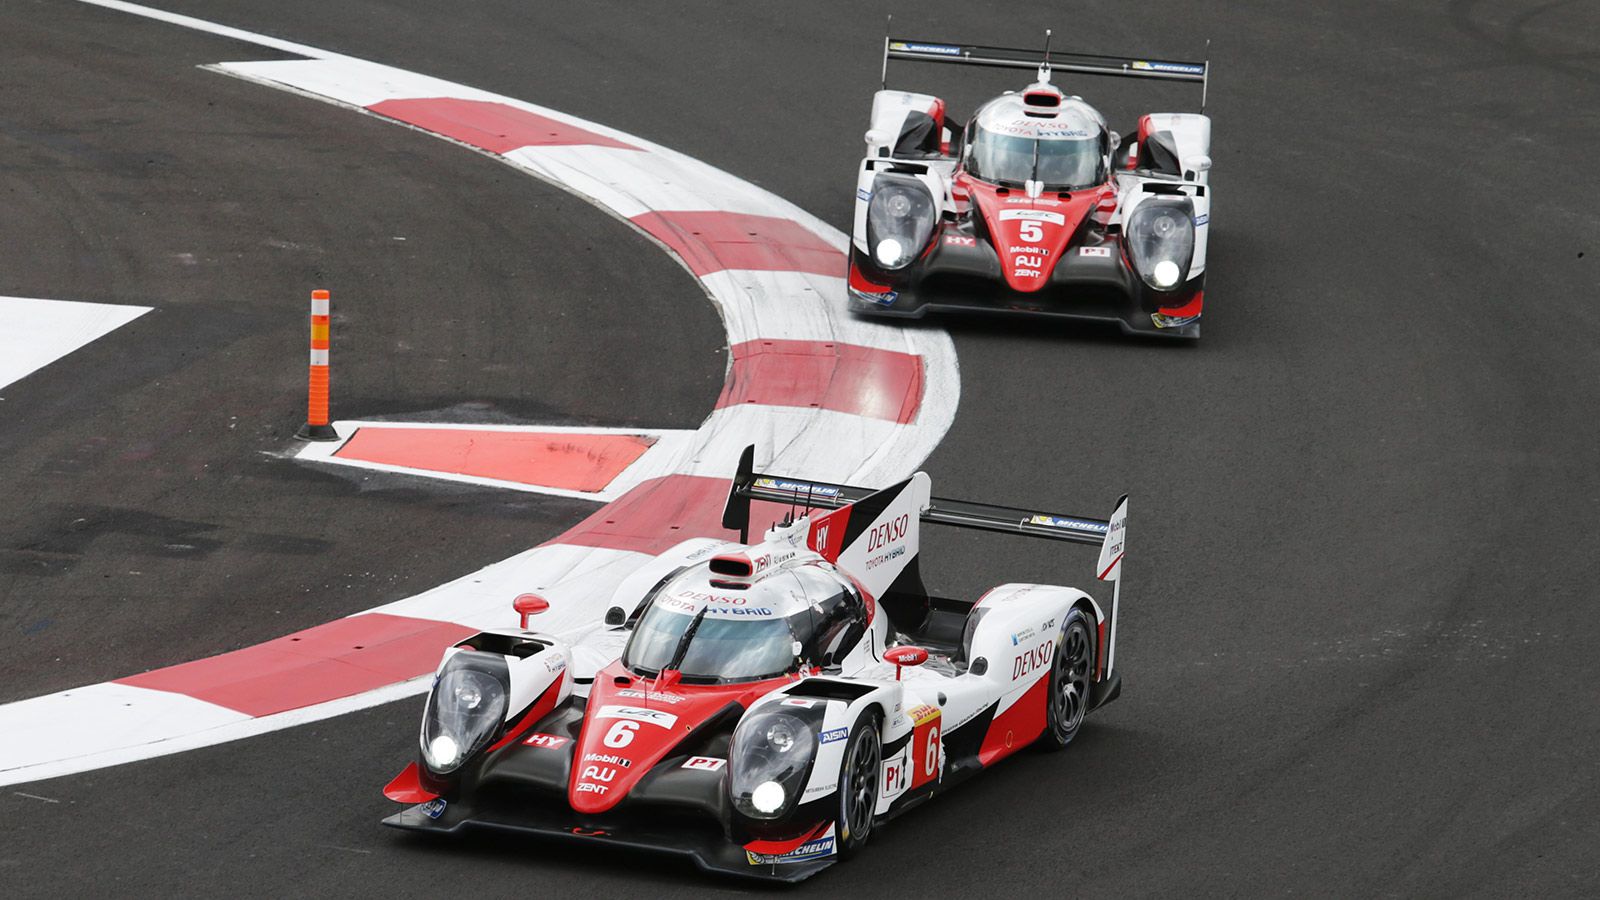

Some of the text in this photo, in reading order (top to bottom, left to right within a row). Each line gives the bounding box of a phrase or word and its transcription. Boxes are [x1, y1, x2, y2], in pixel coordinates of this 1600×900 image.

[1011, 120, 1068, 130] DENSO
[1019, 219, 1044, 243] 5
[946, 235, 974, 246] HY
[1014, 268, 1041, 278] ZENT
[780, 482, 836, 495] MICHELIN
[816, 525, 829, 553] HY
[868, 513, 908, 553] DENSO
[679, 590, 747, 606] DENSO
[704, 607, 772, 616] HYBRID
[1012, 639, 1053, 681] DENSO
[913, 704, 942, 722] DHL
[526, 734, 565, 747] HY
[603, 719, 640, 749] 6
[822, 728, 848, 744] AISIN
[583, 752, 620, 765] Mobil
[925, 726, 938, 776] 6
[689, 758, 719, 768] P1
[886, 765, 900, 793] P1
[576, 782, 609, 795] ZENT
